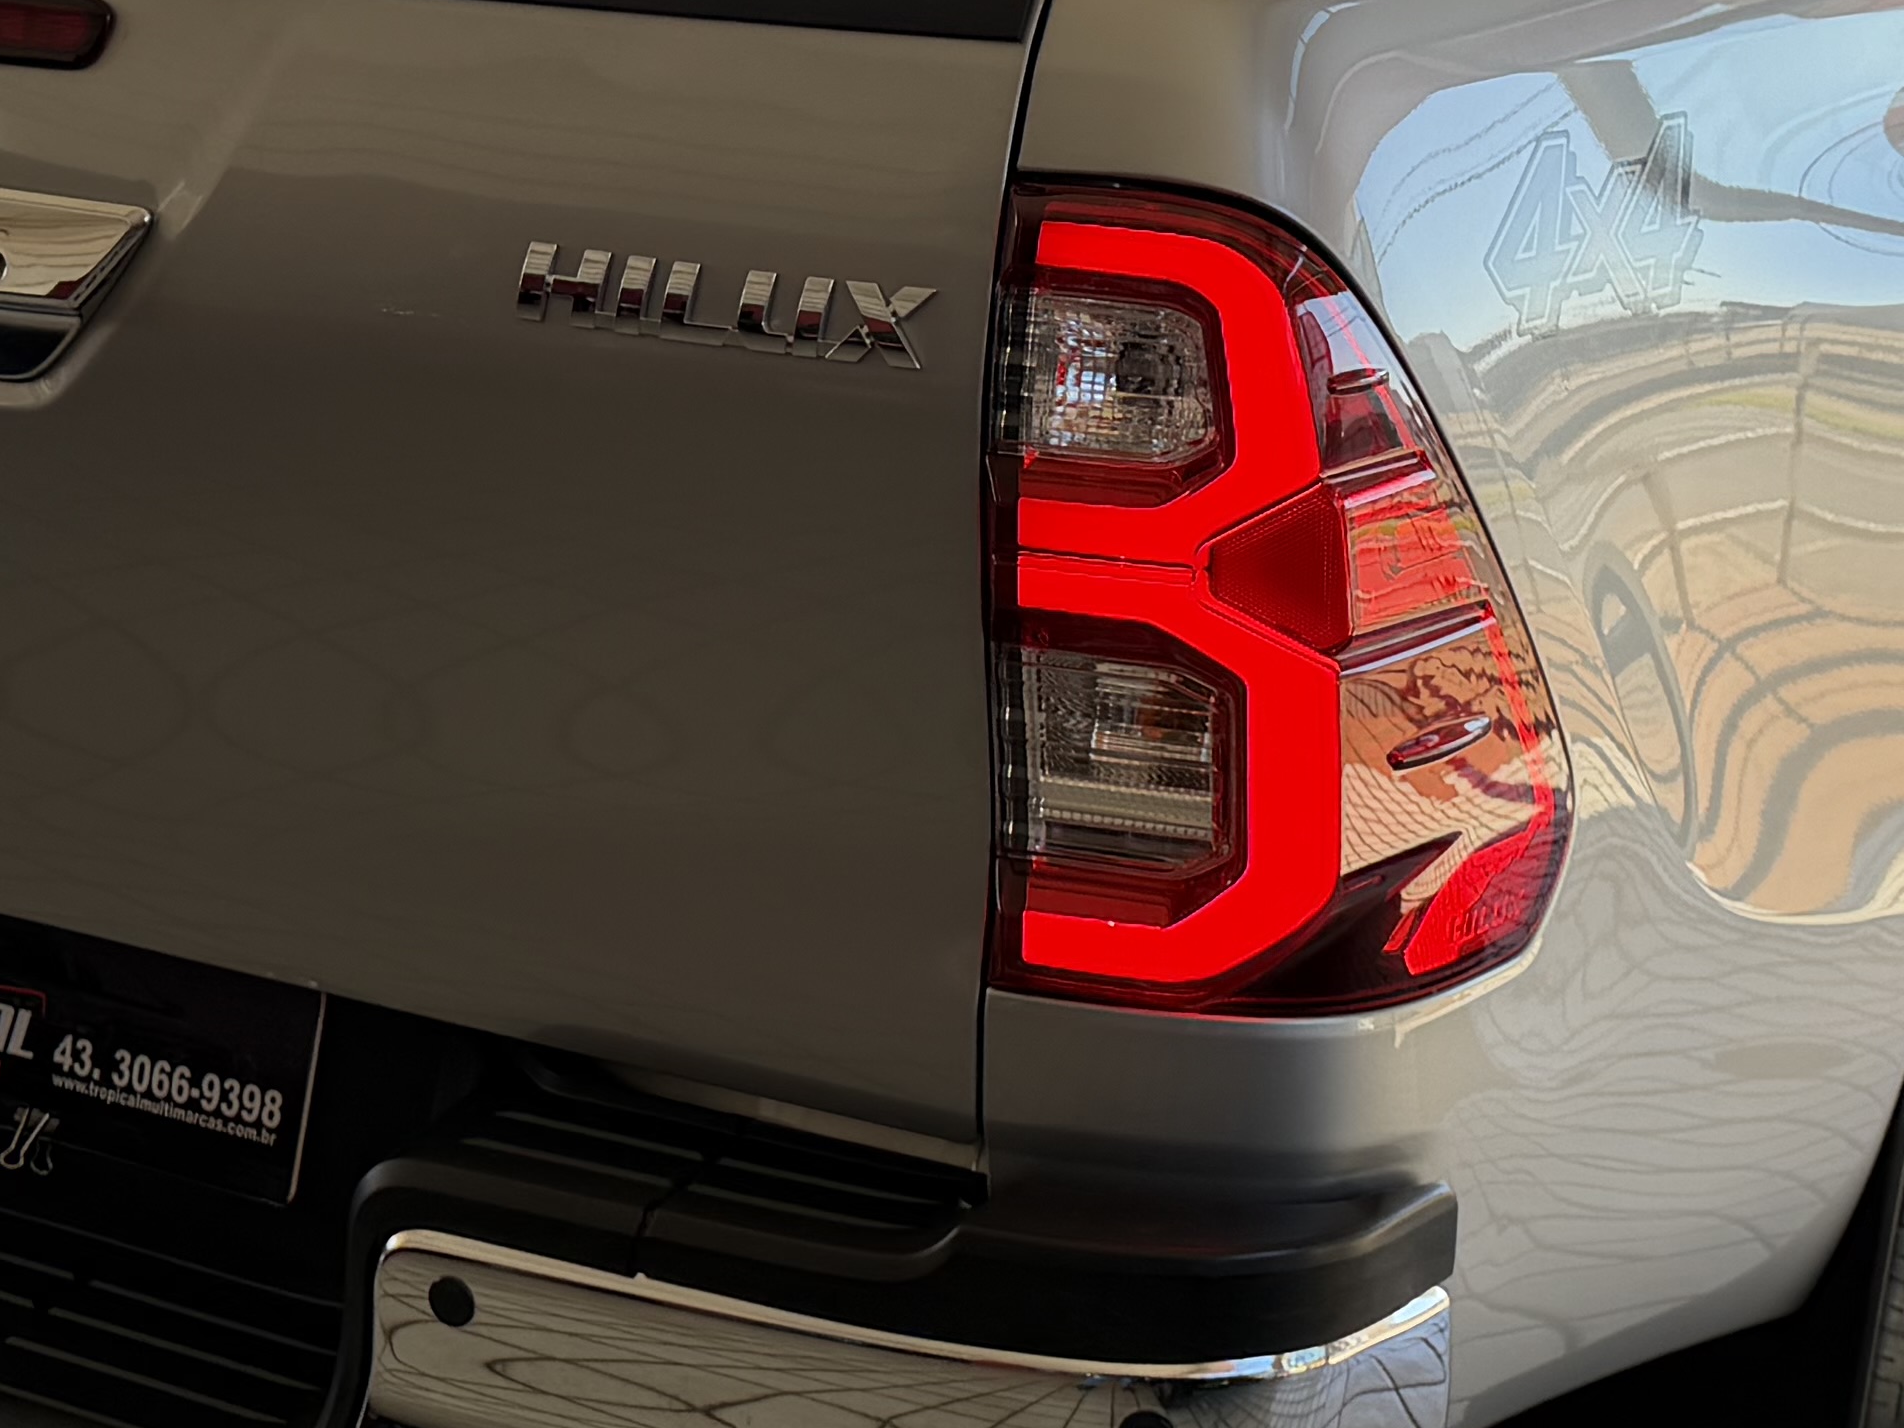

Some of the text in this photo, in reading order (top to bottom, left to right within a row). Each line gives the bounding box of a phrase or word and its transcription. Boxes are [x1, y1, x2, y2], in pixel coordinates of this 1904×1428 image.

[516, 240, 938, 370] HILUX
[52, 1073, 278, 1147] www.tropicalmultimarcas.com.br
[53, 1034, 283, 1129] 43. 3066-9398
